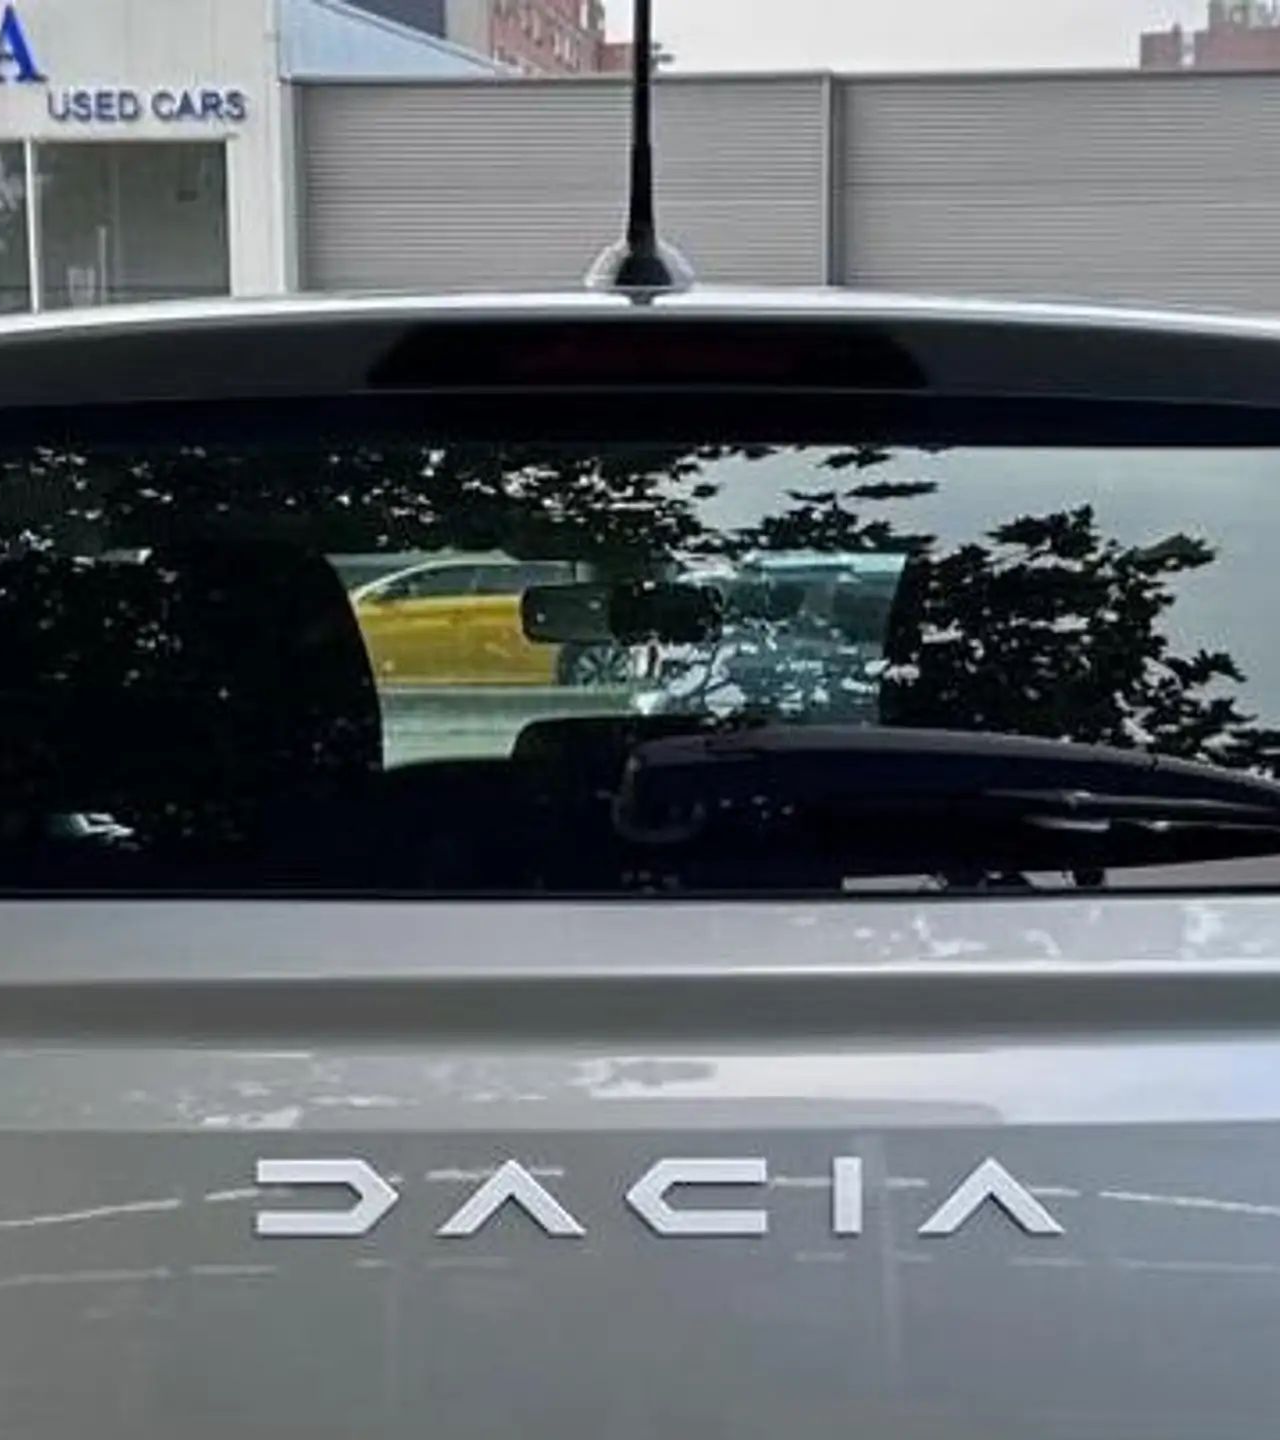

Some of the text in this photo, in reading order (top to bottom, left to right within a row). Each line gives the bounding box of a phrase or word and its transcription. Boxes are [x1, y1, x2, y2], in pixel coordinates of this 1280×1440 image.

[46, 91, 247, 123] USED CARS
[255, 1157, 1065, 1238] DACIA
